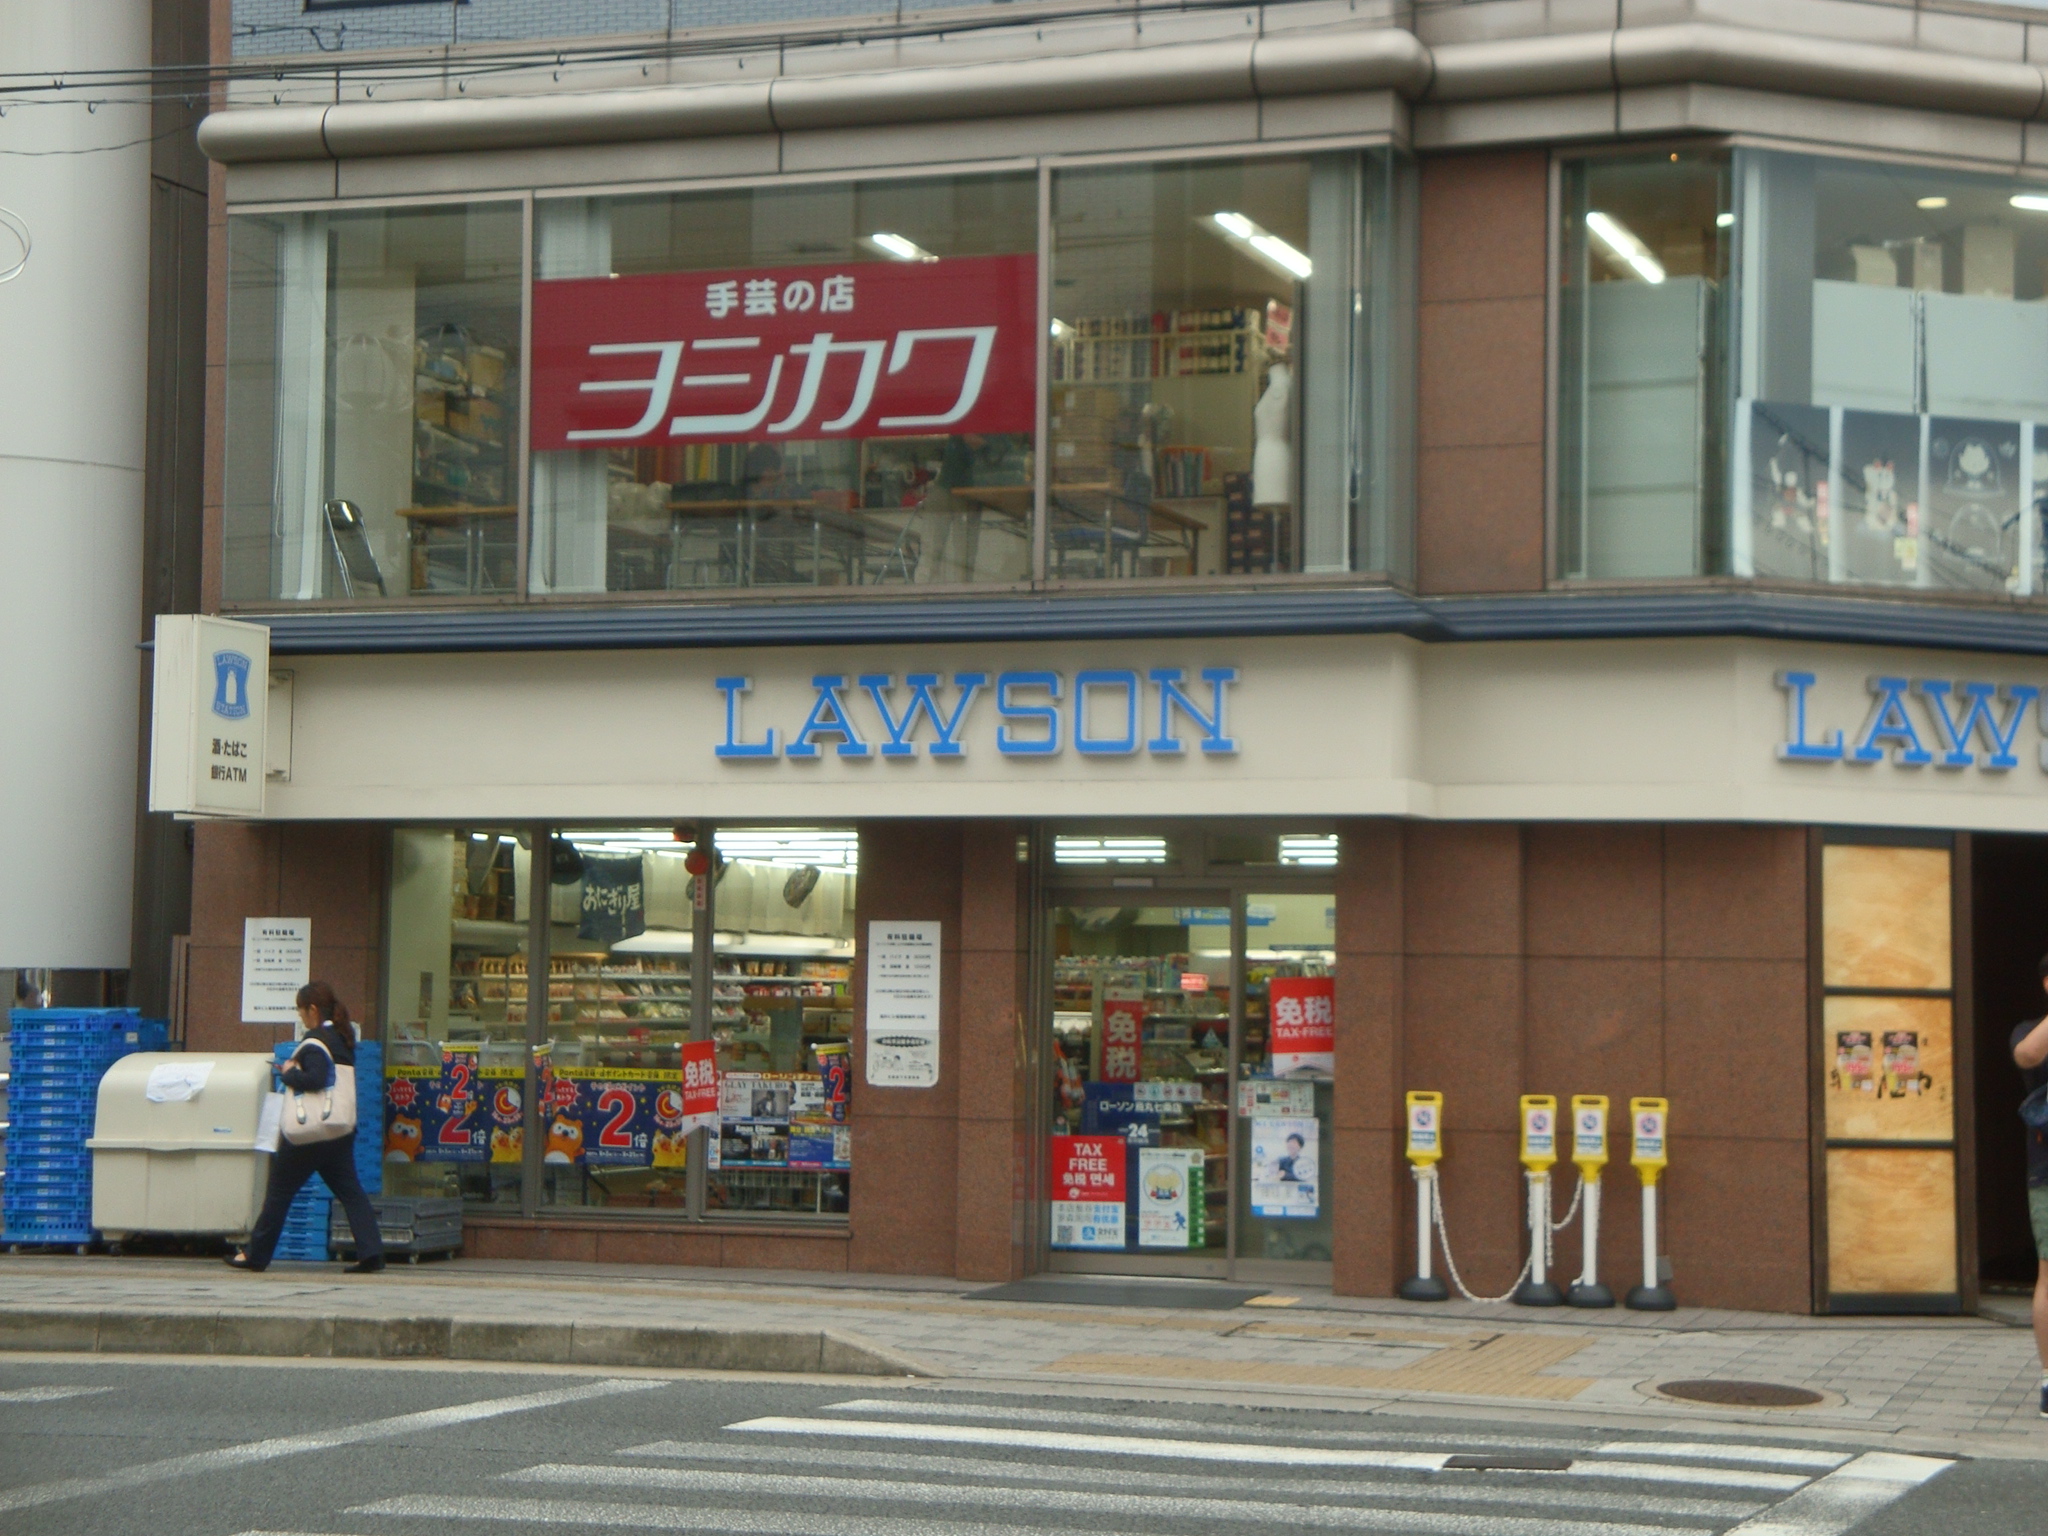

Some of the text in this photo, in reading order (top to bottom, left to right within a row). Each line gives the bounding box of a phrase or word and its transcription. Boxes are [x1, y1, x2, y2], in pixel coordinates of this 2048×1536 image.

[705, 275, 855, 318] 手芸の店
[567, 326, 997, 440] ヨシカワ
[715, 668, 1240, 760] LAWSON
[1777, 671, 2048, 769] LAW
[583, 882, 640, 937] おにぎり屋
[1275, 996, 1332, 1025] 免税
[1105, 1010, 1137, 1079] 免税
[1276, 1026, 1333, 1038] TAX-FREE
[684, 1058, 715, 1088] 免税
[1128, 1123, 1148, 1137] 24
[1069, 1158, 1107, 1171] FREE
[1074, 1143, 1102, 1156] TAX
